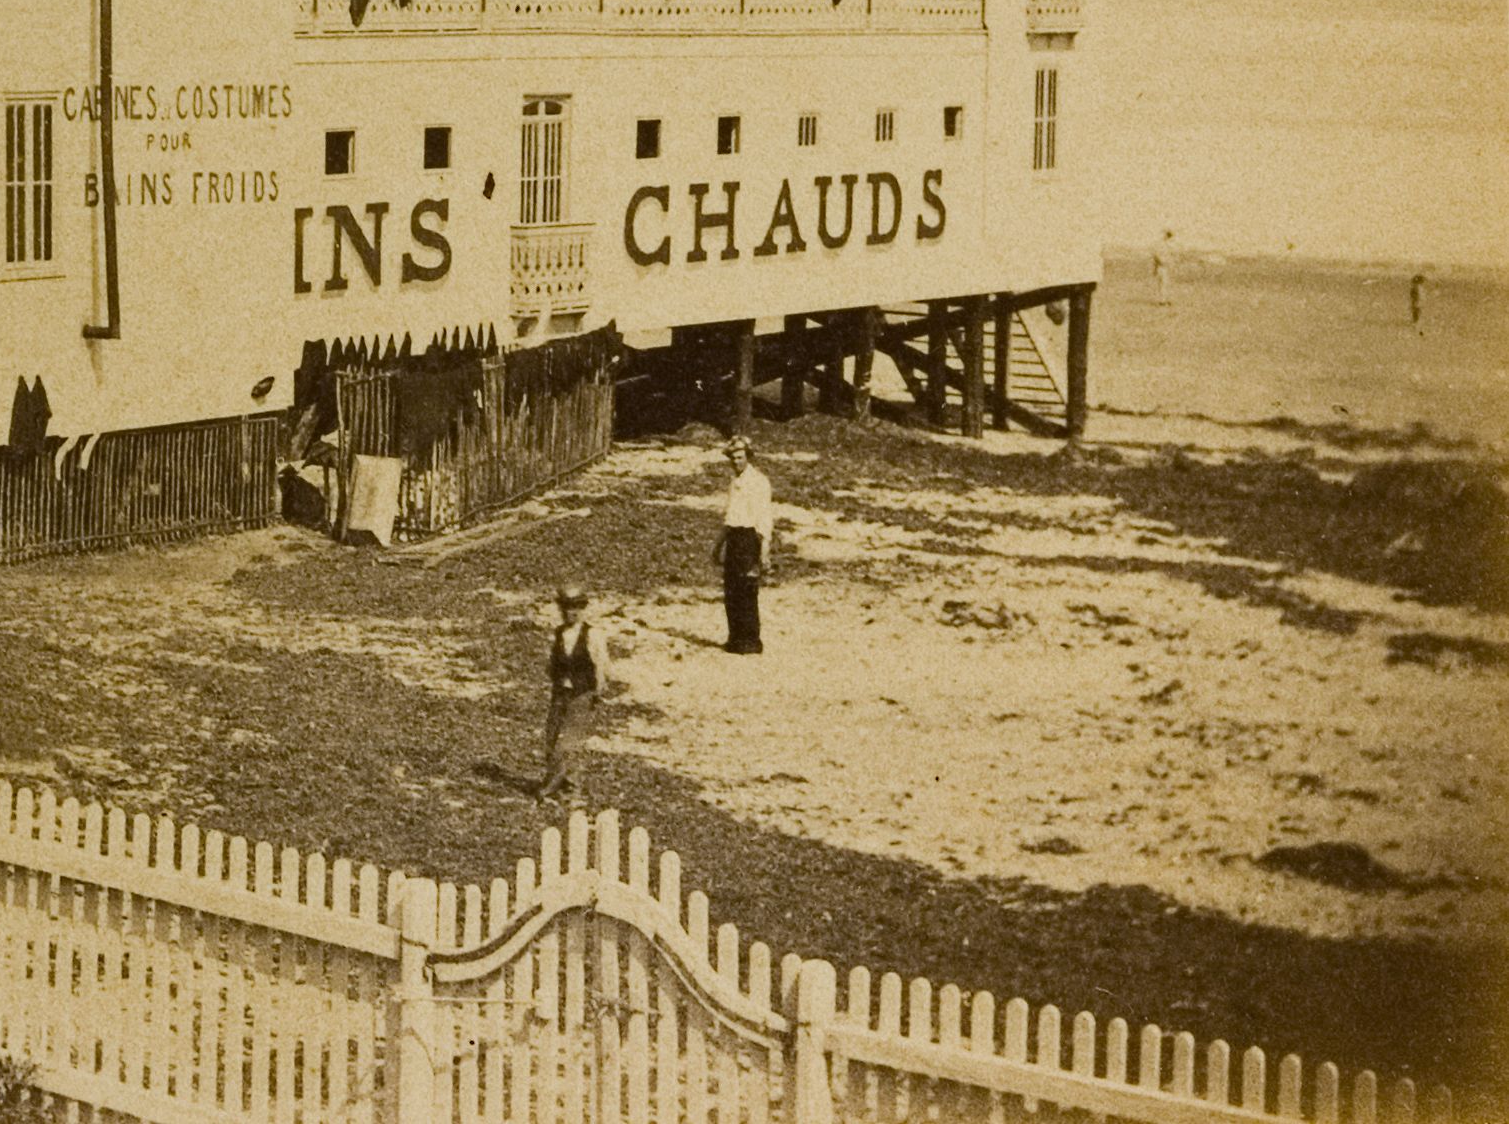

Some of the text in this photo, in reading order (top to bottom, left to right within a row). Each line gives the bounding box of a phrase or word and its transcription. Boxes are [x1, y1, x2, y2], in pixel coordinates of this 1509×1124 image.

[63, 85, 157, 121] CABNES
[176, 84, 292, 119] COSTUMES
[147, 132, 192, 152] POUR
[84, 170, 280, 208] BINS FROIDS
[293, 169, 947, 294] INS CHAUDS
